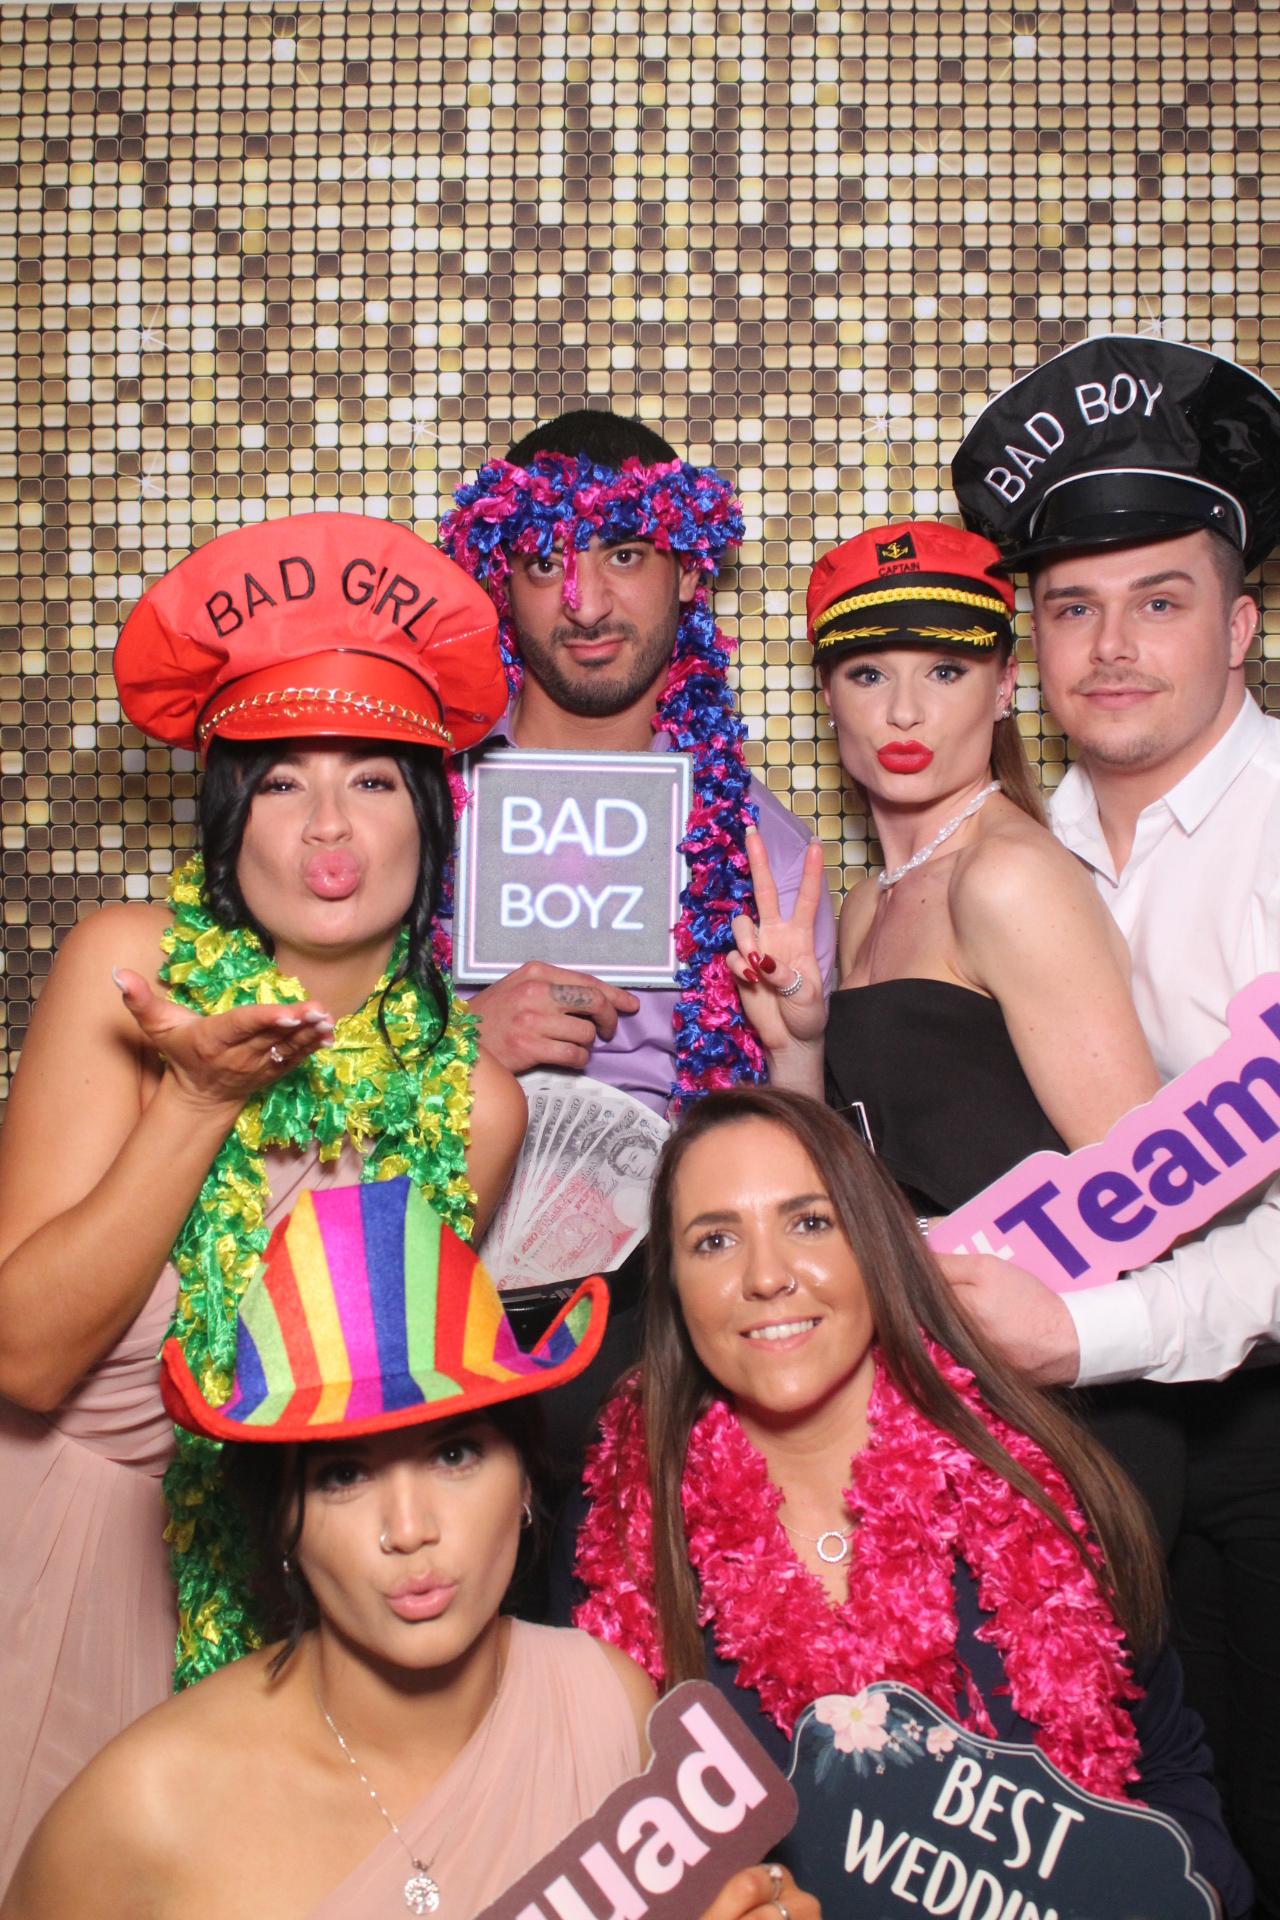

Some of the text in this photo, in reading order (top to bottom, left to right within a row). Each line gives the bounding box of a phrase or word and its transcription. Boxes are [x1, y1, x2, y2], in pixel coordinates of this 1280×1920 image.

[984, 372, 1163, 504] BAD BOY
[205, 556, 438, 643] BAD GIRL
[878, 561, 920, 577] CAPTAIN
[501, 796, 648, 857] BAD
[500, 883, 645, 930] BOYZ
[953, 1002, 1280, 1280] Team
[514, 1702, 768, 1920] uad
[933, 1758, 1085, 1880] BEST
